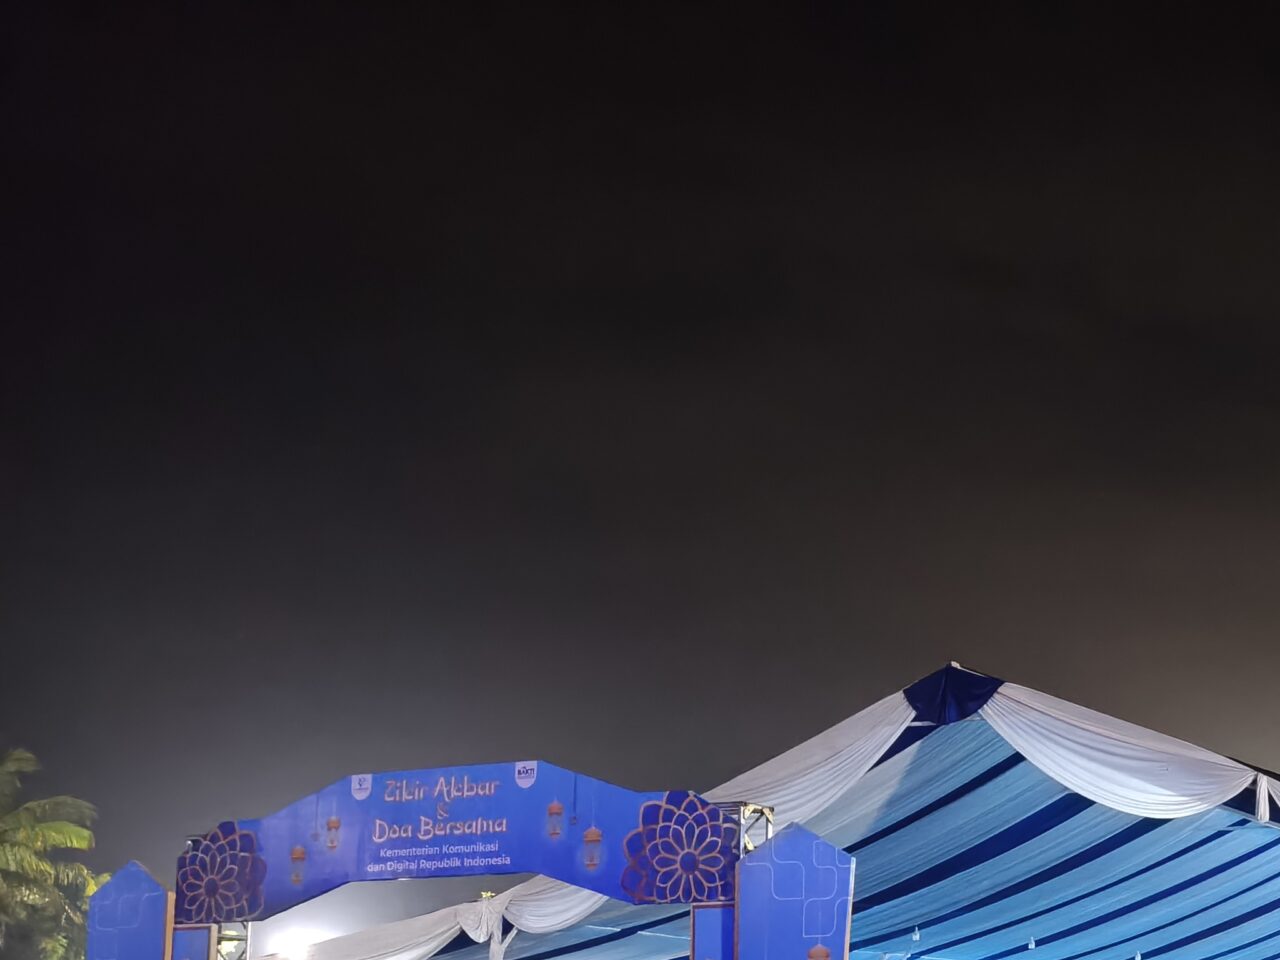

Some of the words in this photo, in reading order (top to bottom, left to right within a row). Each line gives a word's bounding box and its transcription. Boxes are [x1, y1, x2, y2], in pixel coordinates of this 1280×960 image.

[517, 768, 535, 776] BAKTI
[384, 779, 428, 801] Zikir
[434, 776, 499, 802] Akbar
[436, 802, 449, 819] &
[372, 819, 412, 842] Doa
[417, 815, 507, 839] Bersama
[380, 845, 440, 857] Kementerian
[442, 840, 499, 854] Komunikasi
[367, 861, 385, 872] dan
[386, 859, 417, 872] Digital
[420, 857, 461, 870] Republik
[464, 854, 511, 866] Indonesia
